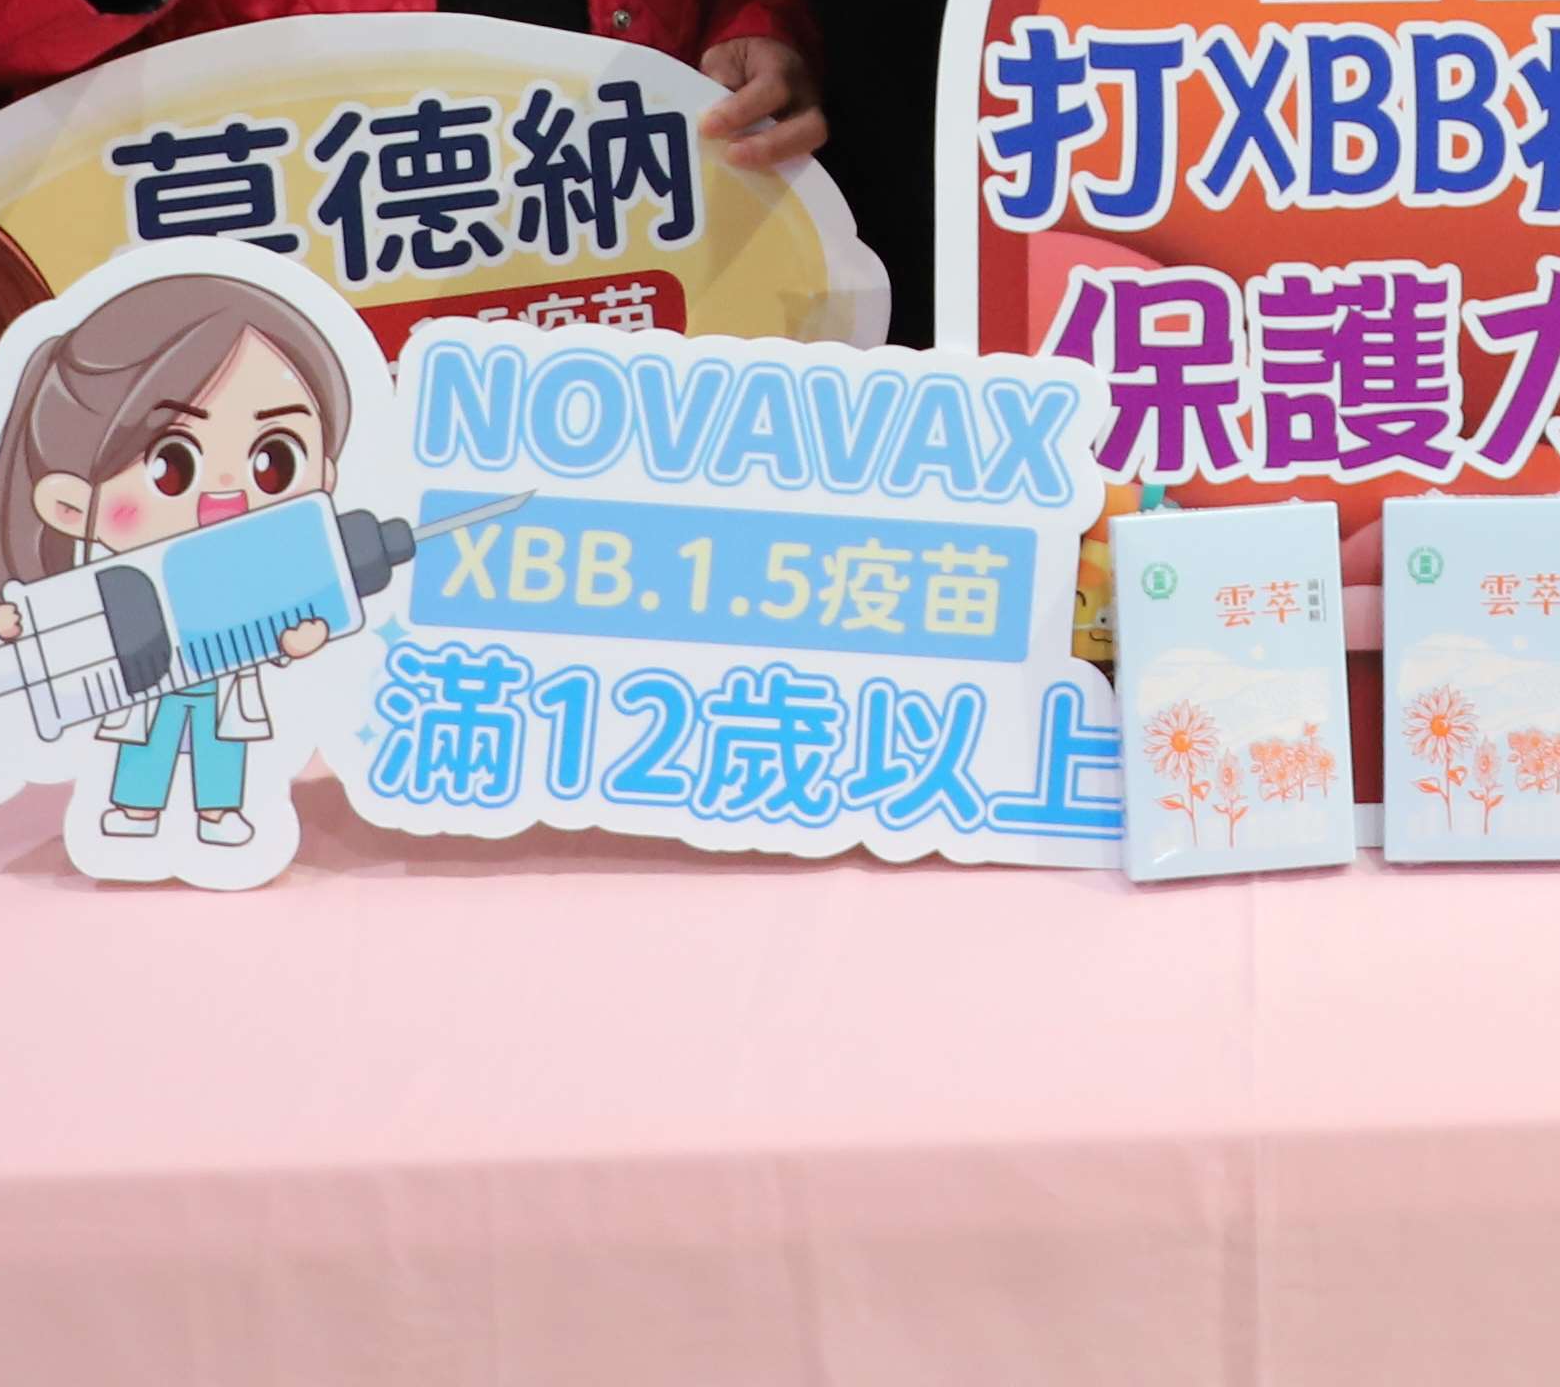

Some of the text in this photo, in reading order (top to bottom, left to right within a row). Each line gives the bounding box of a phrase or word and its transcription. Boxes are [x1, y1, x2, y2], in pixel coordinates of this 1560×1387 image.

[111, 79, 695, 281] 莫德納
[415, 337, 1080, 509] NOVAVAX
[439, 521, 1010, 643] XBB.1.5疫苗
[1215, 580, 1302, 627] 雲萃
[371, 643, 1124, 838] 滿12歲以上
